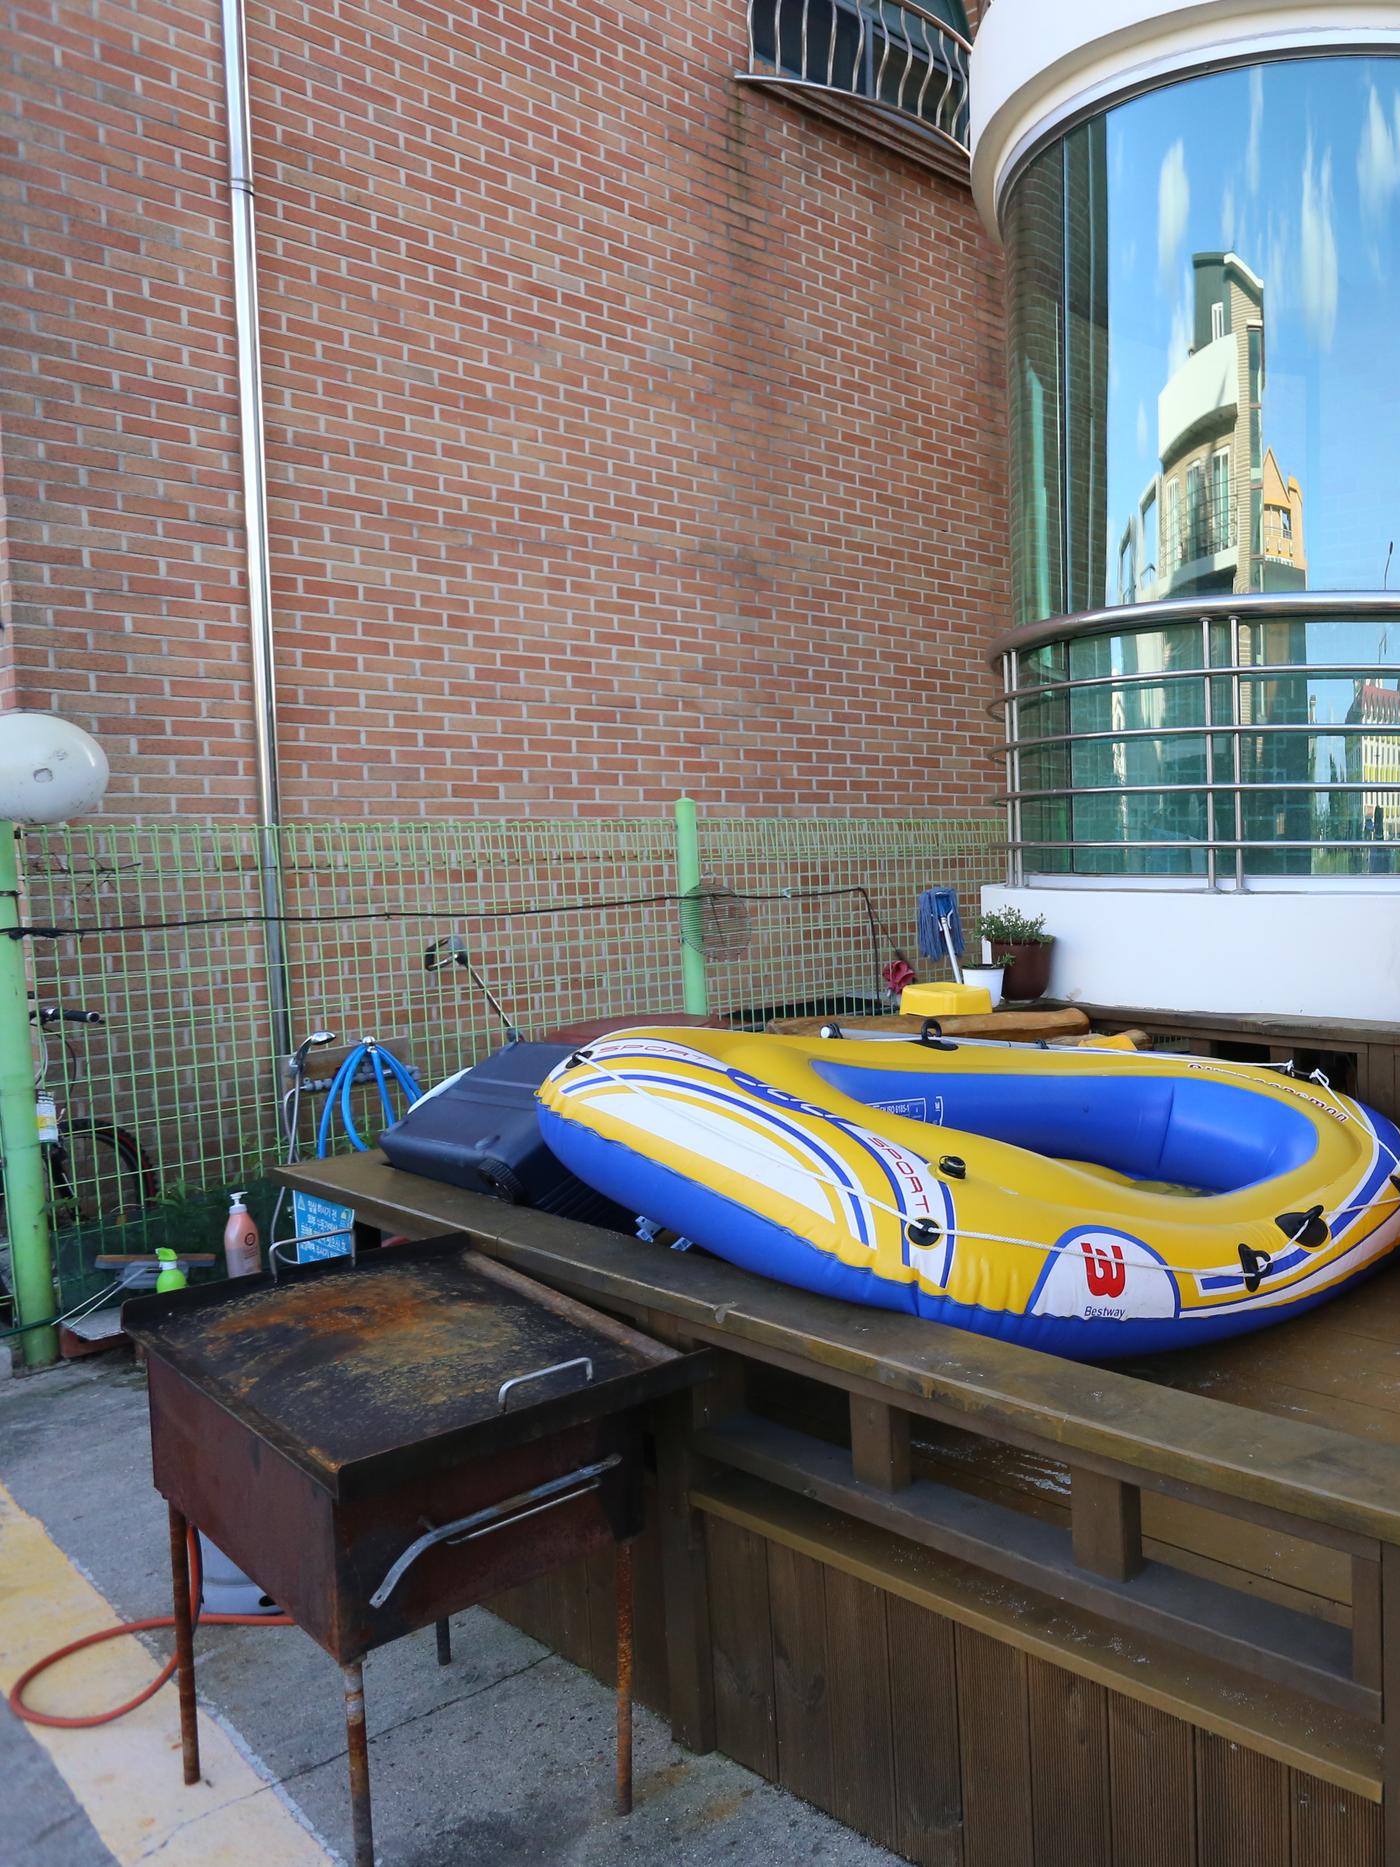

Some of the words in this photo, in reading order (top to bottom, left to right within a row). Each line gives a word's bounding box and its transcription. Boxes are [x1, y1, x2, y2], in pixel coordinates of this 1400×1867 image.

[598, 1044, 713, 1062] SPORT
[865, 1136, 930, 1214] SPORT
[1083, 1305, 1127, 1320] Bestway
